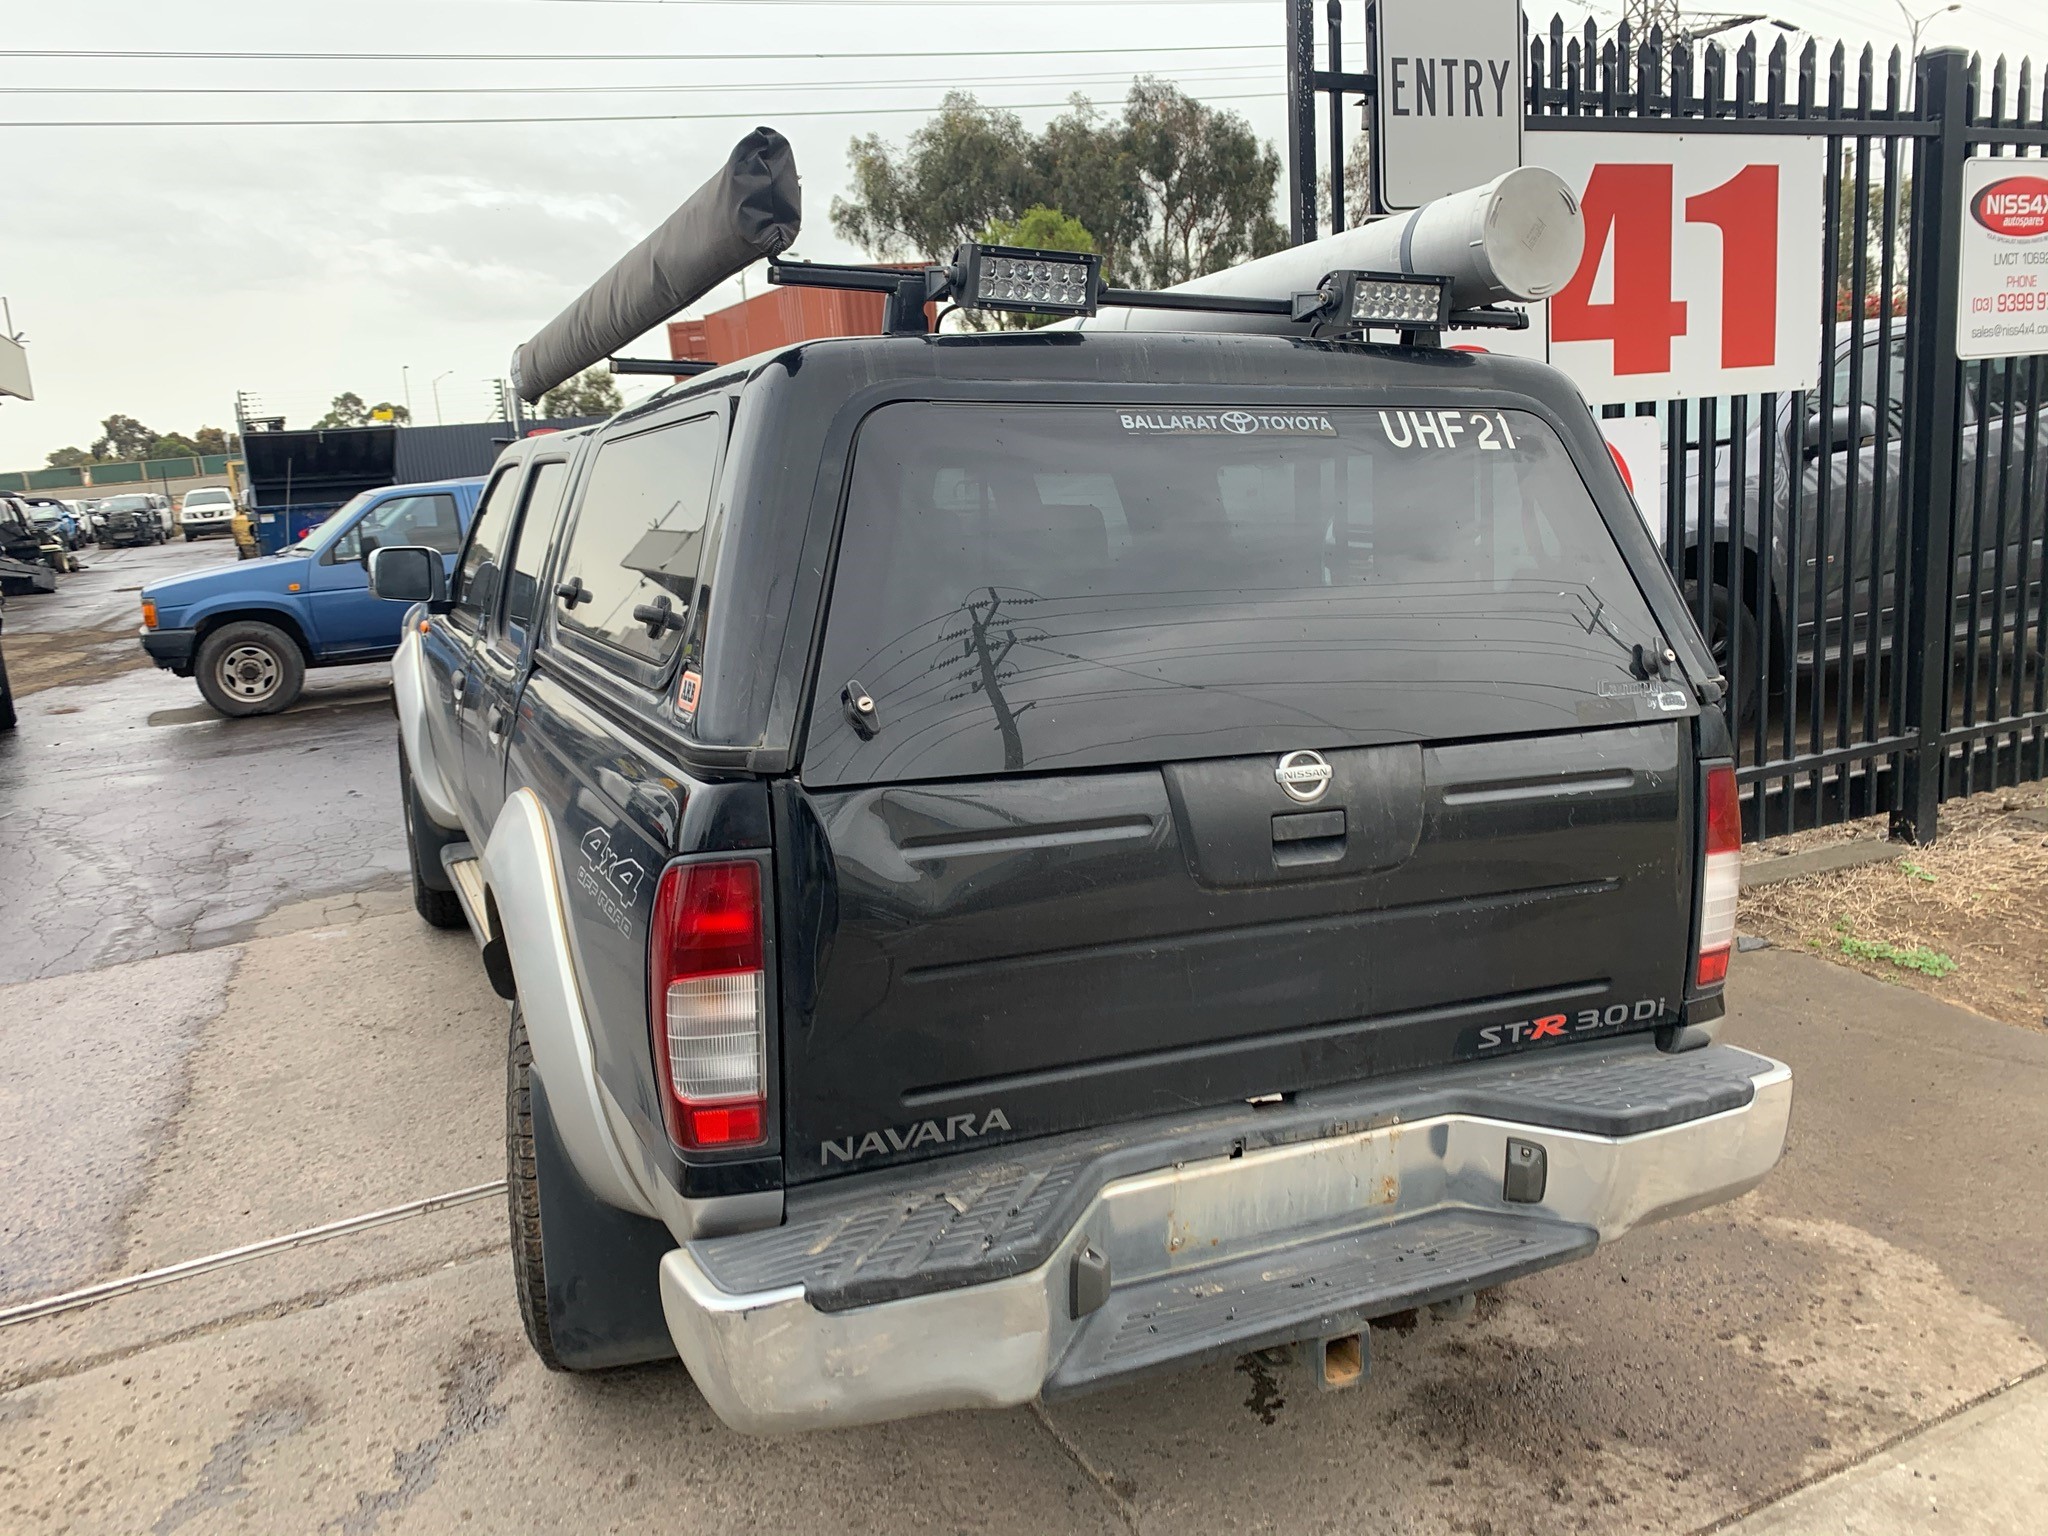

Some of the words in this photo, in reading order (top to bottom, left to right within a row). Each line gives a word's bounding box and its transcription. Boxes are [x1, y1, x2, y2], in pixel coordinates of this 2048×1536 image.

[1391, 57, 1510, 117] ENTRY
[2002, 216, 2044, 228] autospares
[1552, 163, 1780, 376] 41
[1993, 252, 2020, 266] LMCT
[2006, 274, 2038, 288] PHONE
[1972, 296, 1993, 313] (03)
[1997, 292, 2034, 312] 9399
[1120, 415, 1217, 429] BALLARAT
[1257, 416, 1333, 431] TOYOTA
[1378, 411, 1465, 448] UHF
[1468, 412, 1516, 450] 21
[1284, 768, 1328, 780] NISSAN
[1478, 1013, 1570, 1050] ST-R
[821, 1107, 1012, 1166] NAVARA
